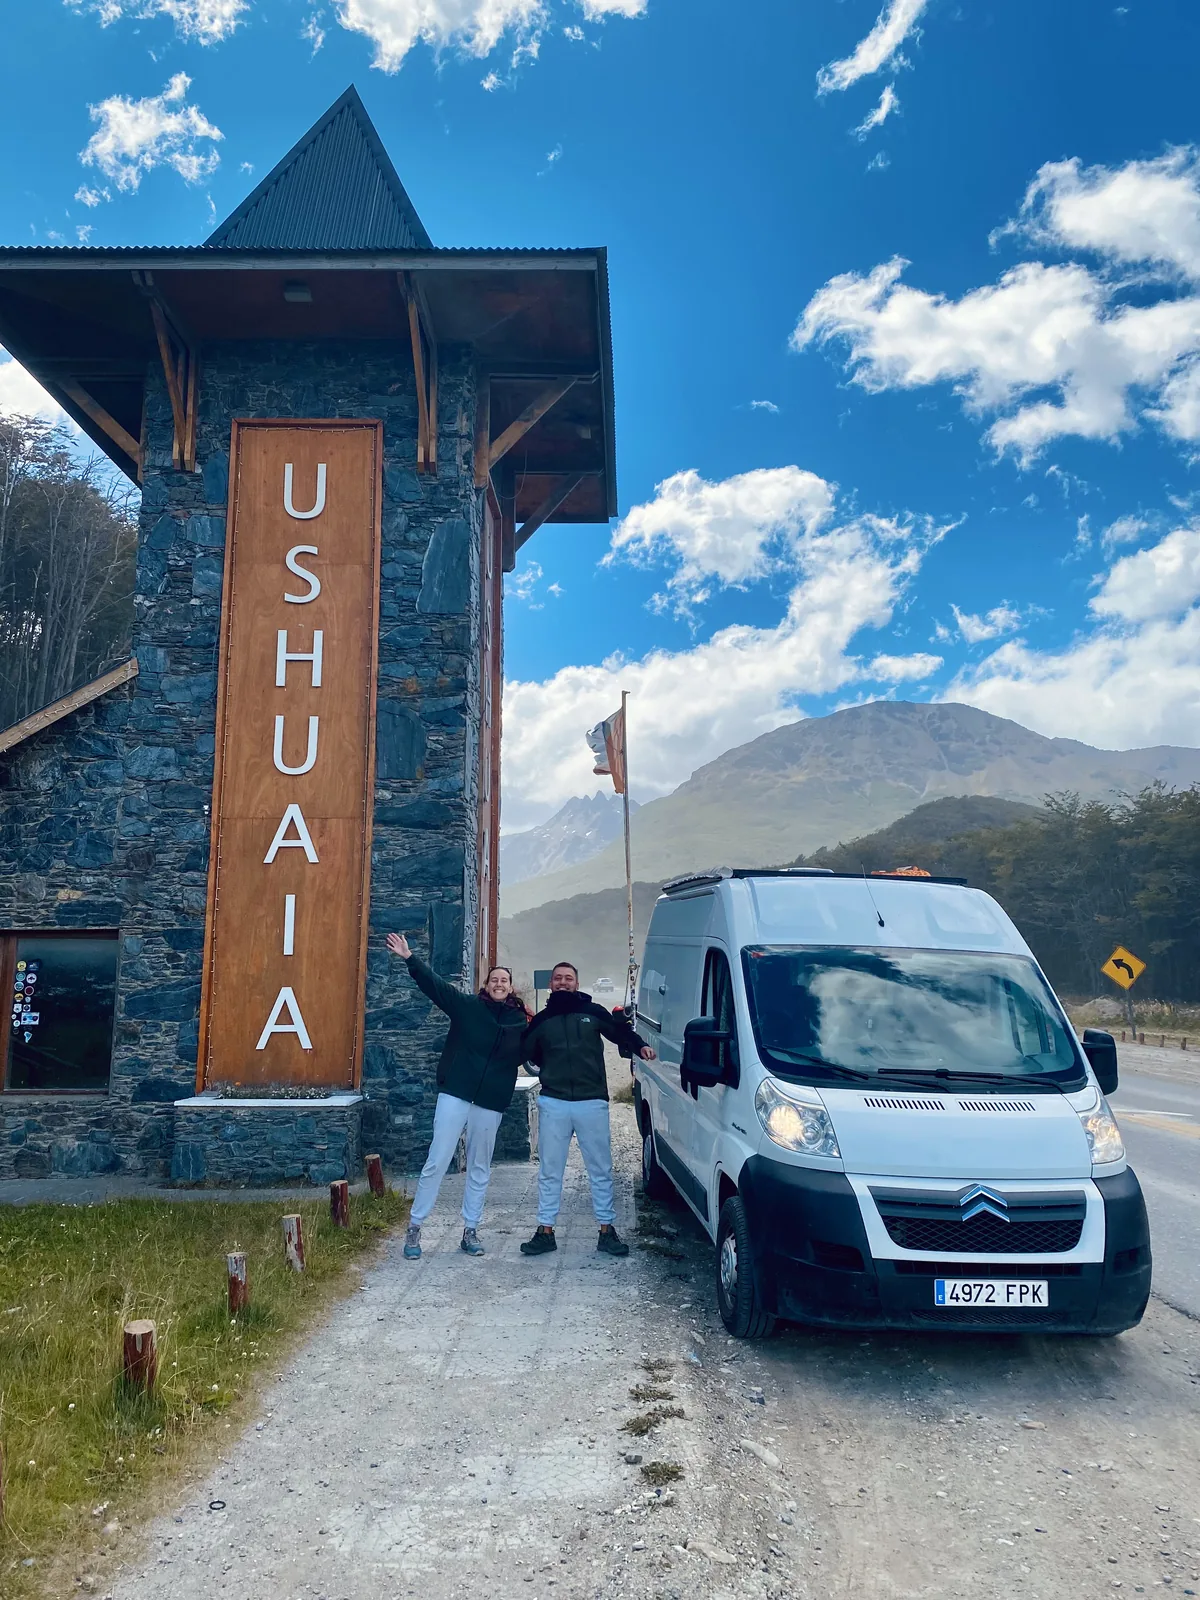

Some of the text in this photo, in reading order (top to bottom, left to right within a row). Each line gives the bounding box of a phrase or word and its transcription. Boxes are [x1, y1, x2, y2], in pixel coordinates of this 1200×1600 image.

[256, 463, 327, 1050] USHUAIA
[949, 1283, 996, 1303] 4972
[1006, 1284, 1043, 1304] FPK
